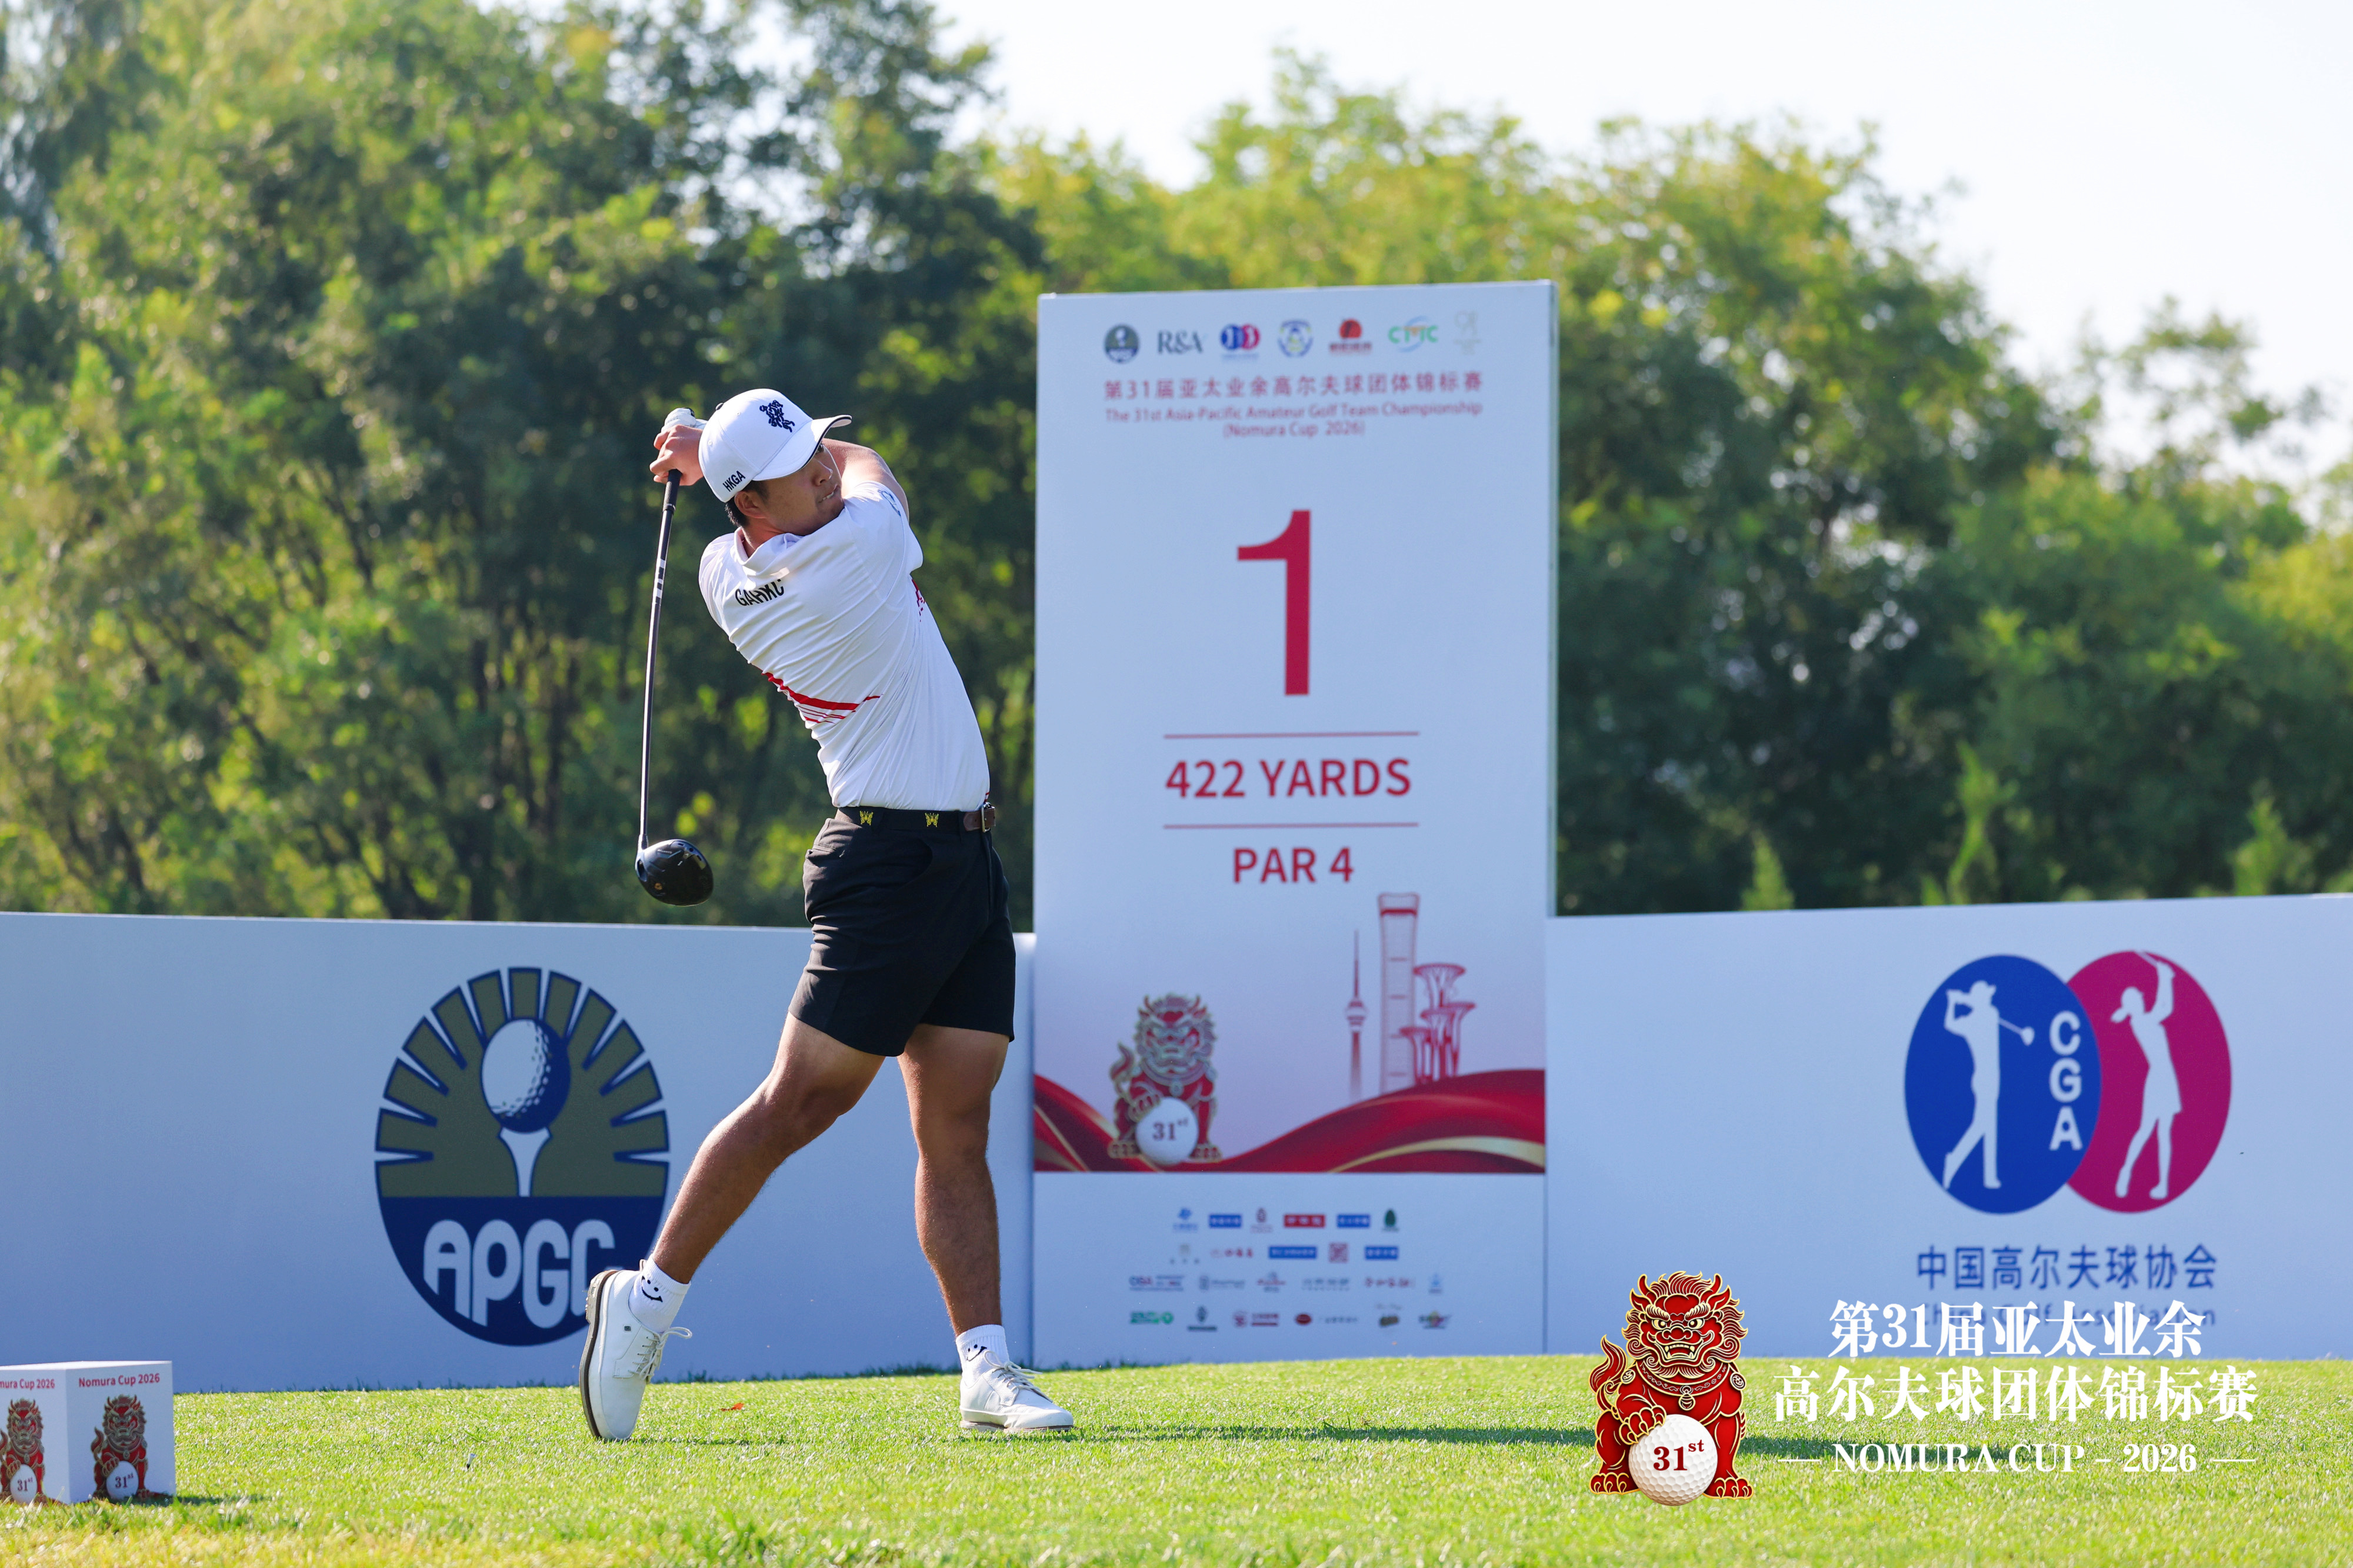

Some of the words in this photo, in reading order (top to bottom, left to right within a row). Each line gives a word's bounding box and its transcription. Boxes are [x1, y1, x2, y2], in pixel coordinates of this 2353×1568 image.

[1157, 330, 1203, 353] R&A
[1104, 372, 1482, 401] 第31届亚太业余高尔夫球团体锦标赛
[1105, 408, 1129, 422] The
[1134, 408, 1161, 422] 31st
[1247, 405, 1304, 419] Amateur
[1309, 403, 1338, 418] Golf
[1341, 402, 1379, 416] Team
[1382, 401, 1482, 417] Championship
[1224, 423, 1287, 438] (Nomura
[1289, 421, 1318, 438] Cup
[1325, 419, 1365, 436] 2026)
[722, 471, 746, 492] HKGA
[1238, 510, 1311, 695] 1
[1165, 761, 1245, 798] 422
[1259, 758, 1411, 797] YARDS
[1234, 847, 1317, 883] PAR
[1329, 848, 1354, 883] 4
[2049, 1010, 2082, 1150] CGA
[423, 1219, 622, 1329] APGC
[1917, 1243, 2217, 1290] 中国高尔夫球协会
[19, 1379, 35, 1391] Cup
[36, 1379, 55, 1389] 2026
[79, 1377, 116, 1387] Nomura
[118, 1375, 136, 1386] Cup
[138, 1373, 160, 1383] 2026
